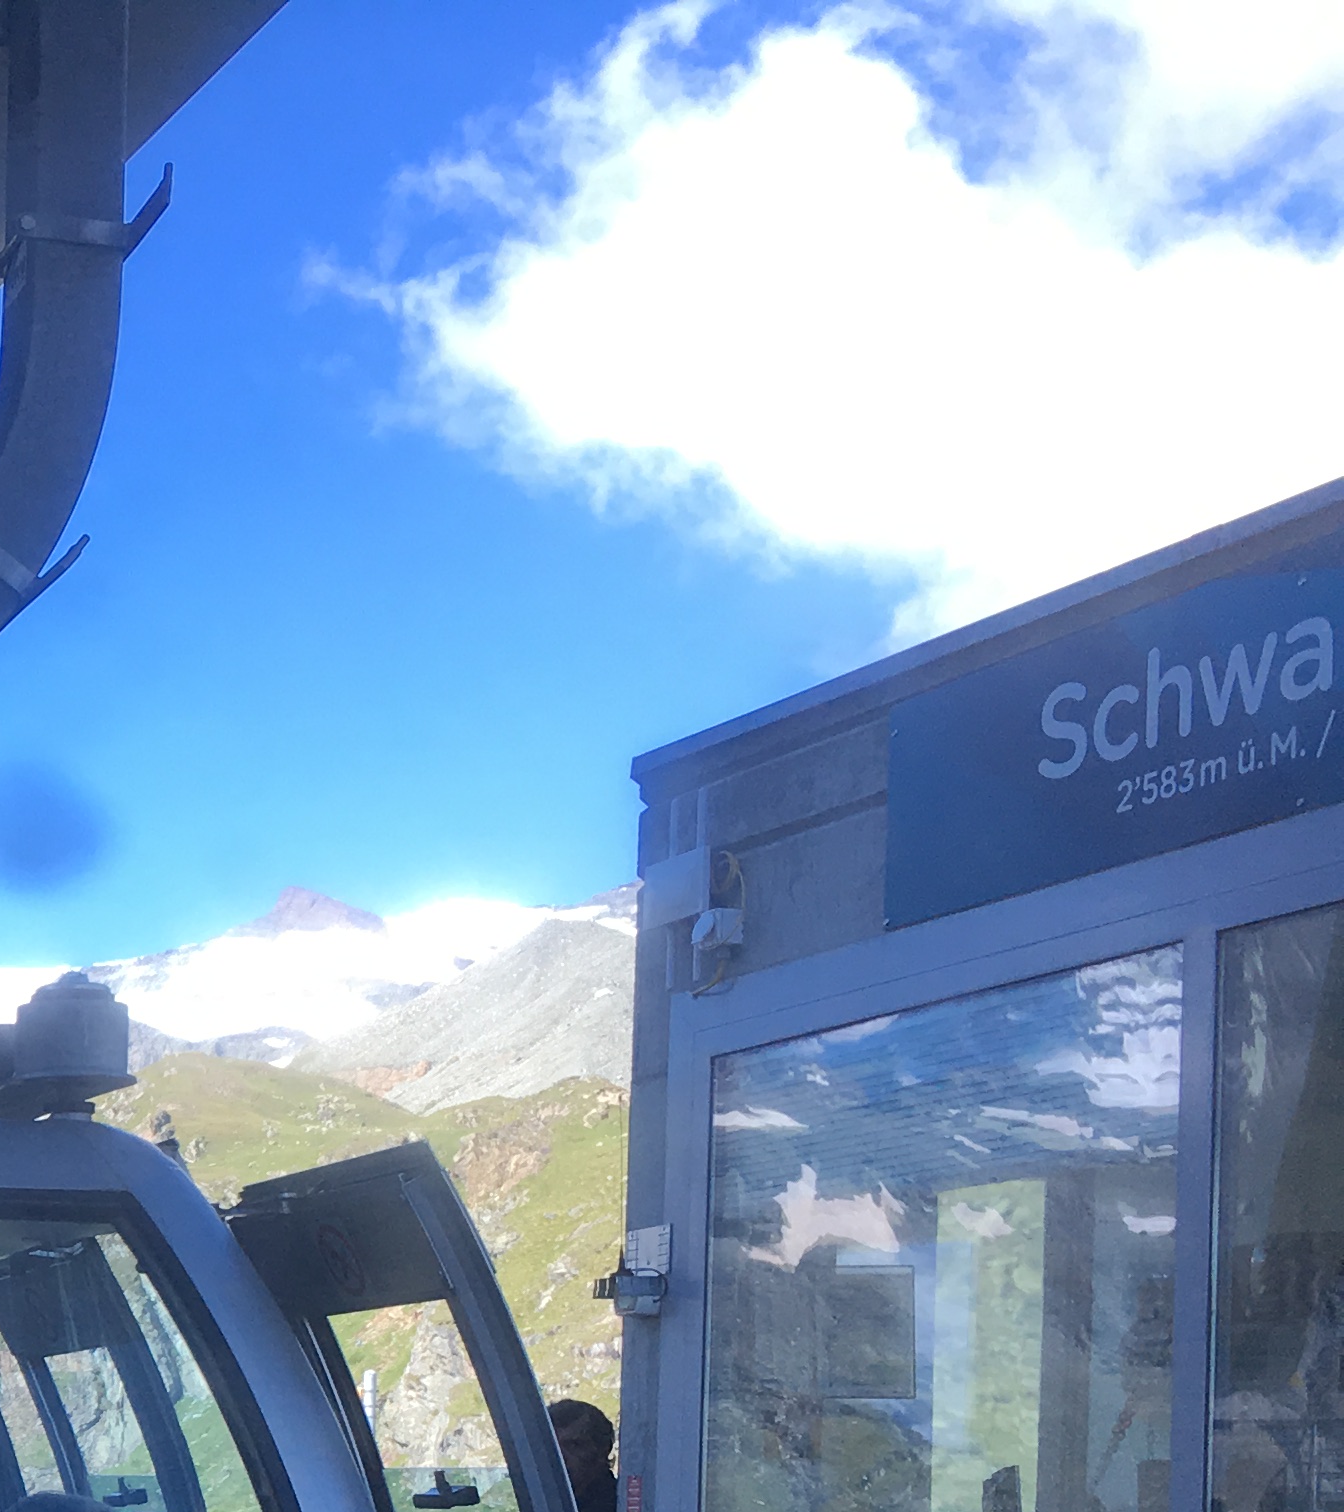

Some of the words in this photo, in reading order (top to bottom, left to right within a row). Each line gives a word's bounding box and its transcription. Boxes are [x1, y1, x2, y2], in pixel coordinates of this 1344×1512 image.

[1037, 615, 1334, 779] Schwa
[1115, 756, 1227, 814] 2'583m
[1237, 738, 1264, 775] ü.
[1269, 725, 1307, 766] M.
